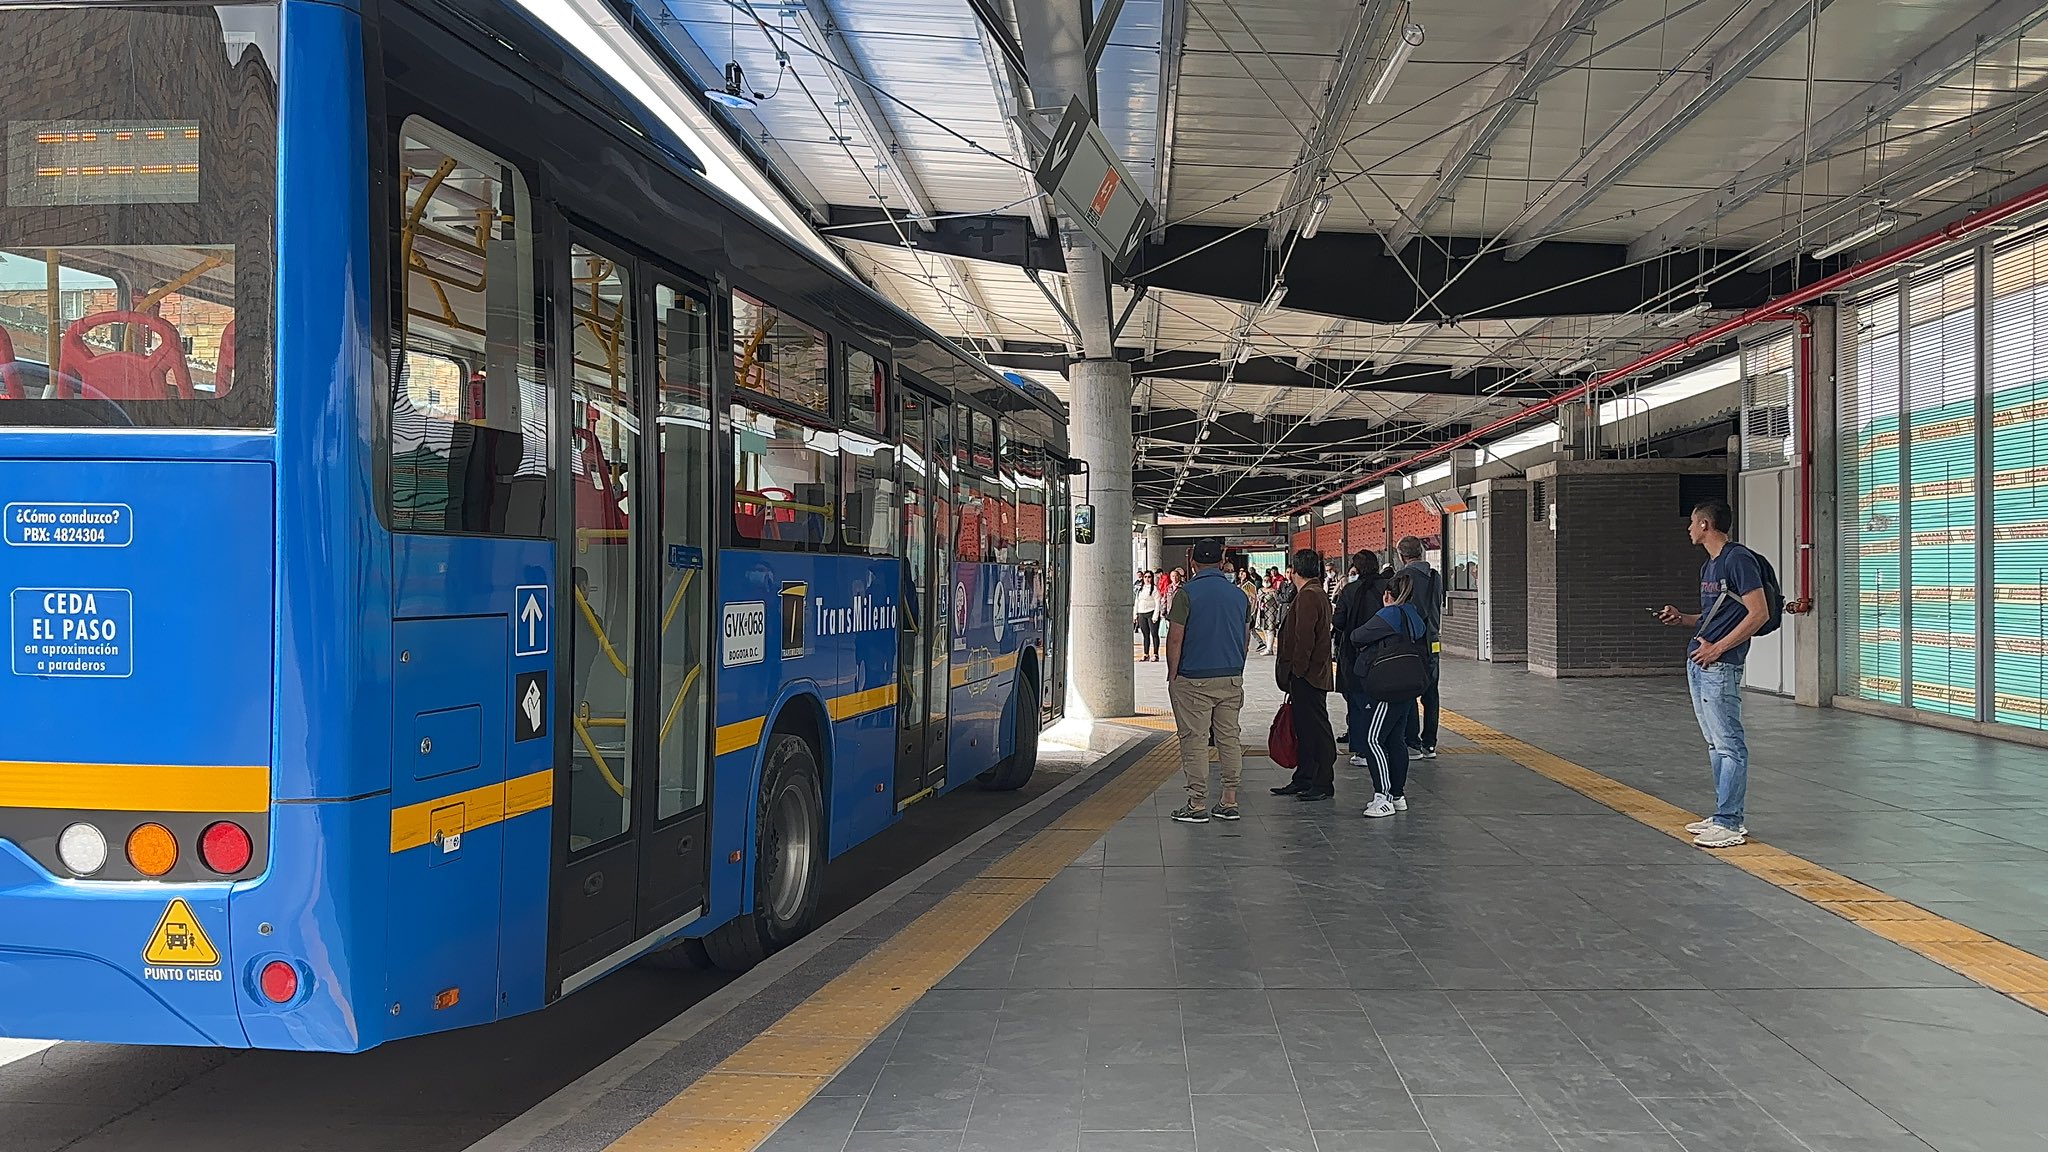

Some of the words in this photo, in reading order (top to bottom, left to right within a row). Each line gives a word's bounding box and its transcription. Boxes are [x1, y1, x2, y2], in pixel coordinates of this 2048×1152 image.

[16, 509, 57, 524] ¿Cómo
[59, 509, 120, 525] conduzco?
[23, 528, 51, 542] PBX:
[53, 528, 105, 543] 4824304
[43, 593, 97, 615] CEDA
[815, 594, 898, 636] TransMilenio
[32, 618, 54, 640] EL
[63, 619, 116, 641] PASO
[24, 644, 38, 655] en
[42, 642, 118, 659] aproximación
[729, 648, 749, 661] BOGOTA
[37, 661, 45, 670] a
[48, 658, 106, 673] paraderos
[144, 967, 183, 981] PUNTO
[186, 969, 222, 982] CIEGO
